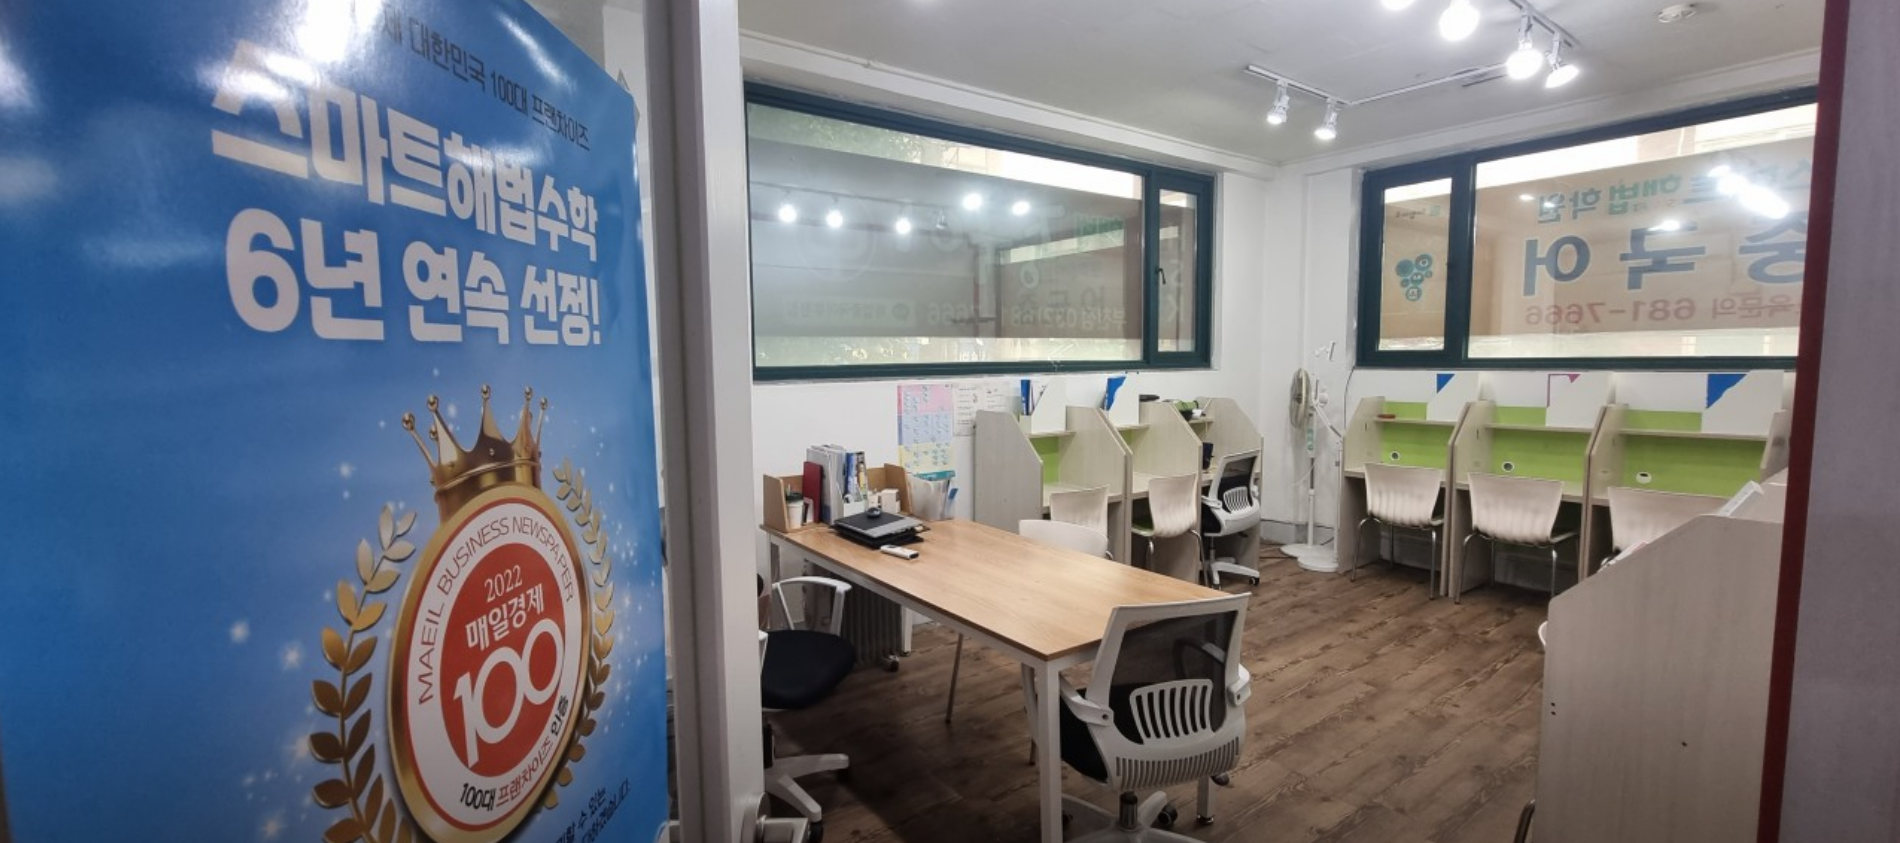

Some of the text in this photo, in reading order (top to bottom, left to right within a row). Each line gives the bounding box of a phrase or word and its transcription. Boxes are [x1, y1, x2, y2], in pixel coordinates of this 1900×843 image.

[211, 39, 598, 262] 스마트해법수학
[407, 15, 486, 94] 대한민국
[491, 69, 528, 117] 100대
[532, 93, 591, 152] 프랜차이즈
[225, 208, 600, 347] 6년 연속 선정!
[418, 515, 574, 705] MAEIL BUSINESS NEWSPAPER
[464, 583, 545, 650] 매일경제
[483, 564, 523, 603] 2022
[453, 617, 565, 769] 100
[459, 695, 570, 811] 100대 프랜차이즈 인증
